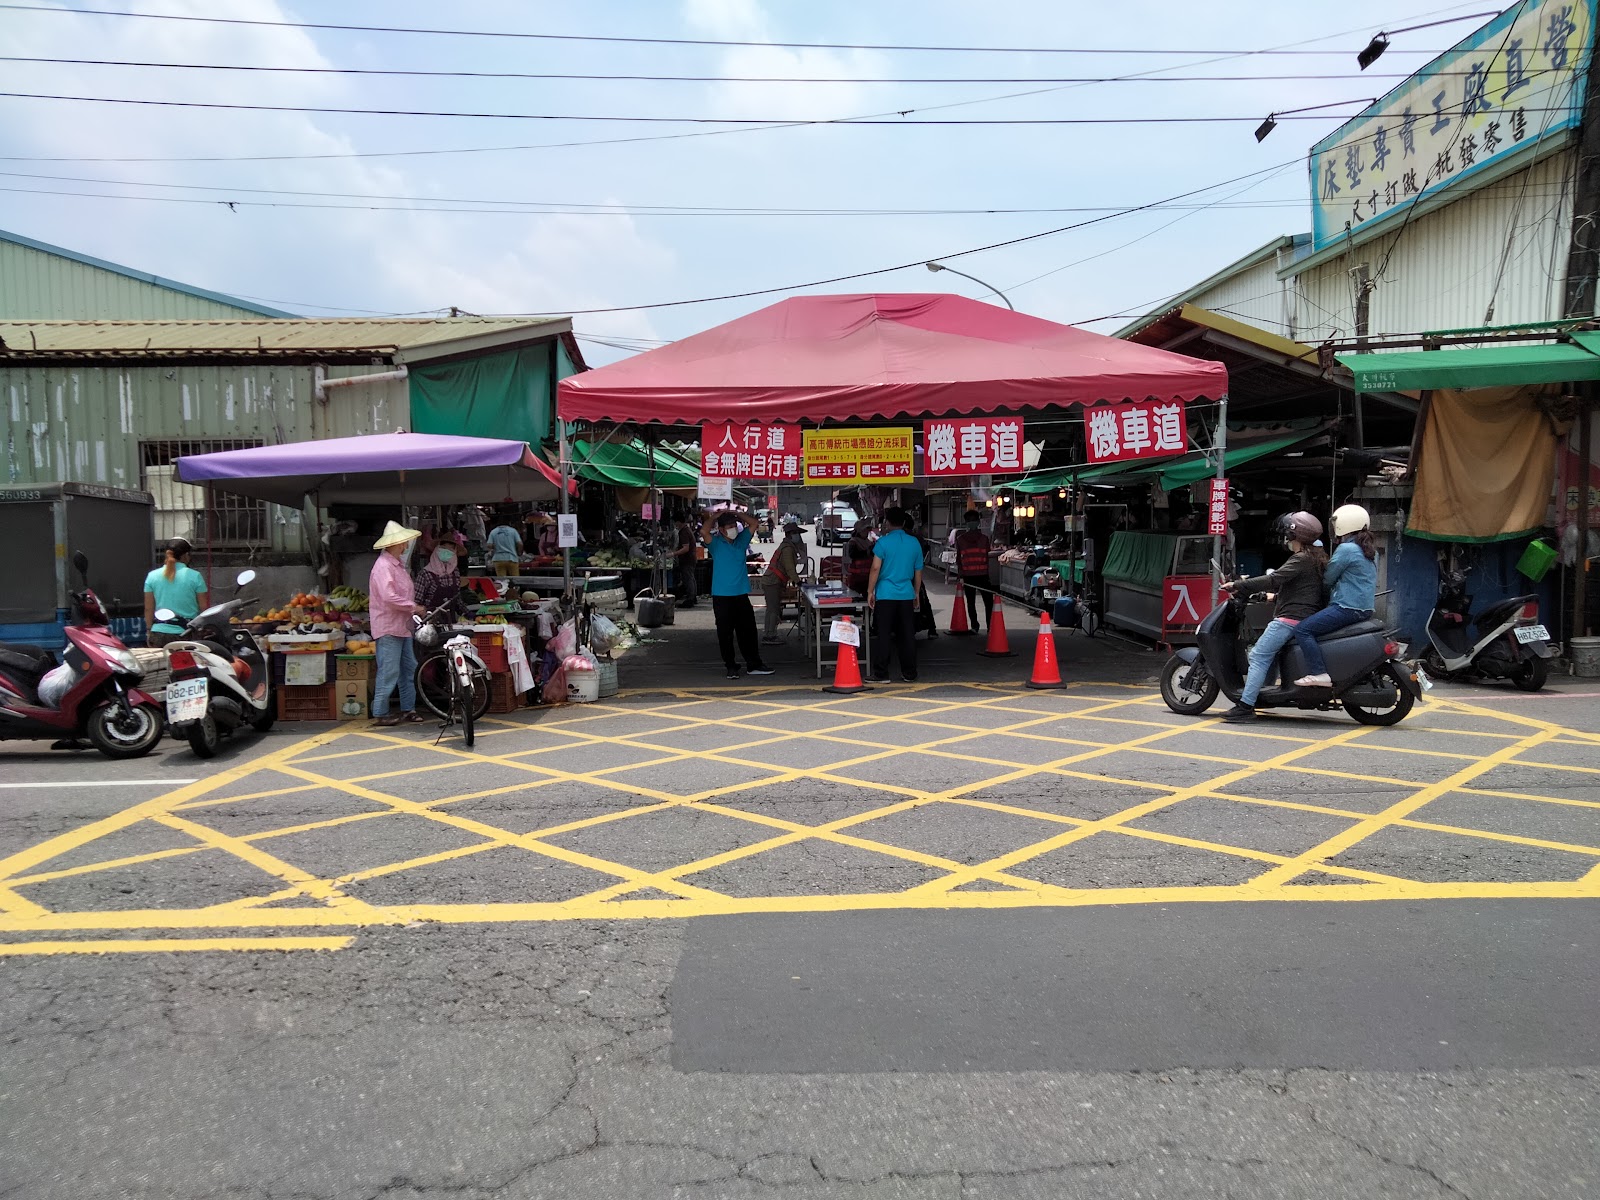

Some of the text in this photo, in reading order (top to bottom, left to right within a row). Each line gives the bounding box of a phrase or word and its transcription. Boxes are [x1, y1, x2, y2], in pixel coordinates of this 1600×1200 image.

[719, 426, 785, 450] 人行道
[928, 421, 1020, 471] 機車道
[1089, 403, 1184, 458] 機車道
[704, 451, 798, 477] 含無牌自行車
[1211, 479, 1226, 533] 車牌錄影中
[1166, 585, 1199, 621] 入
